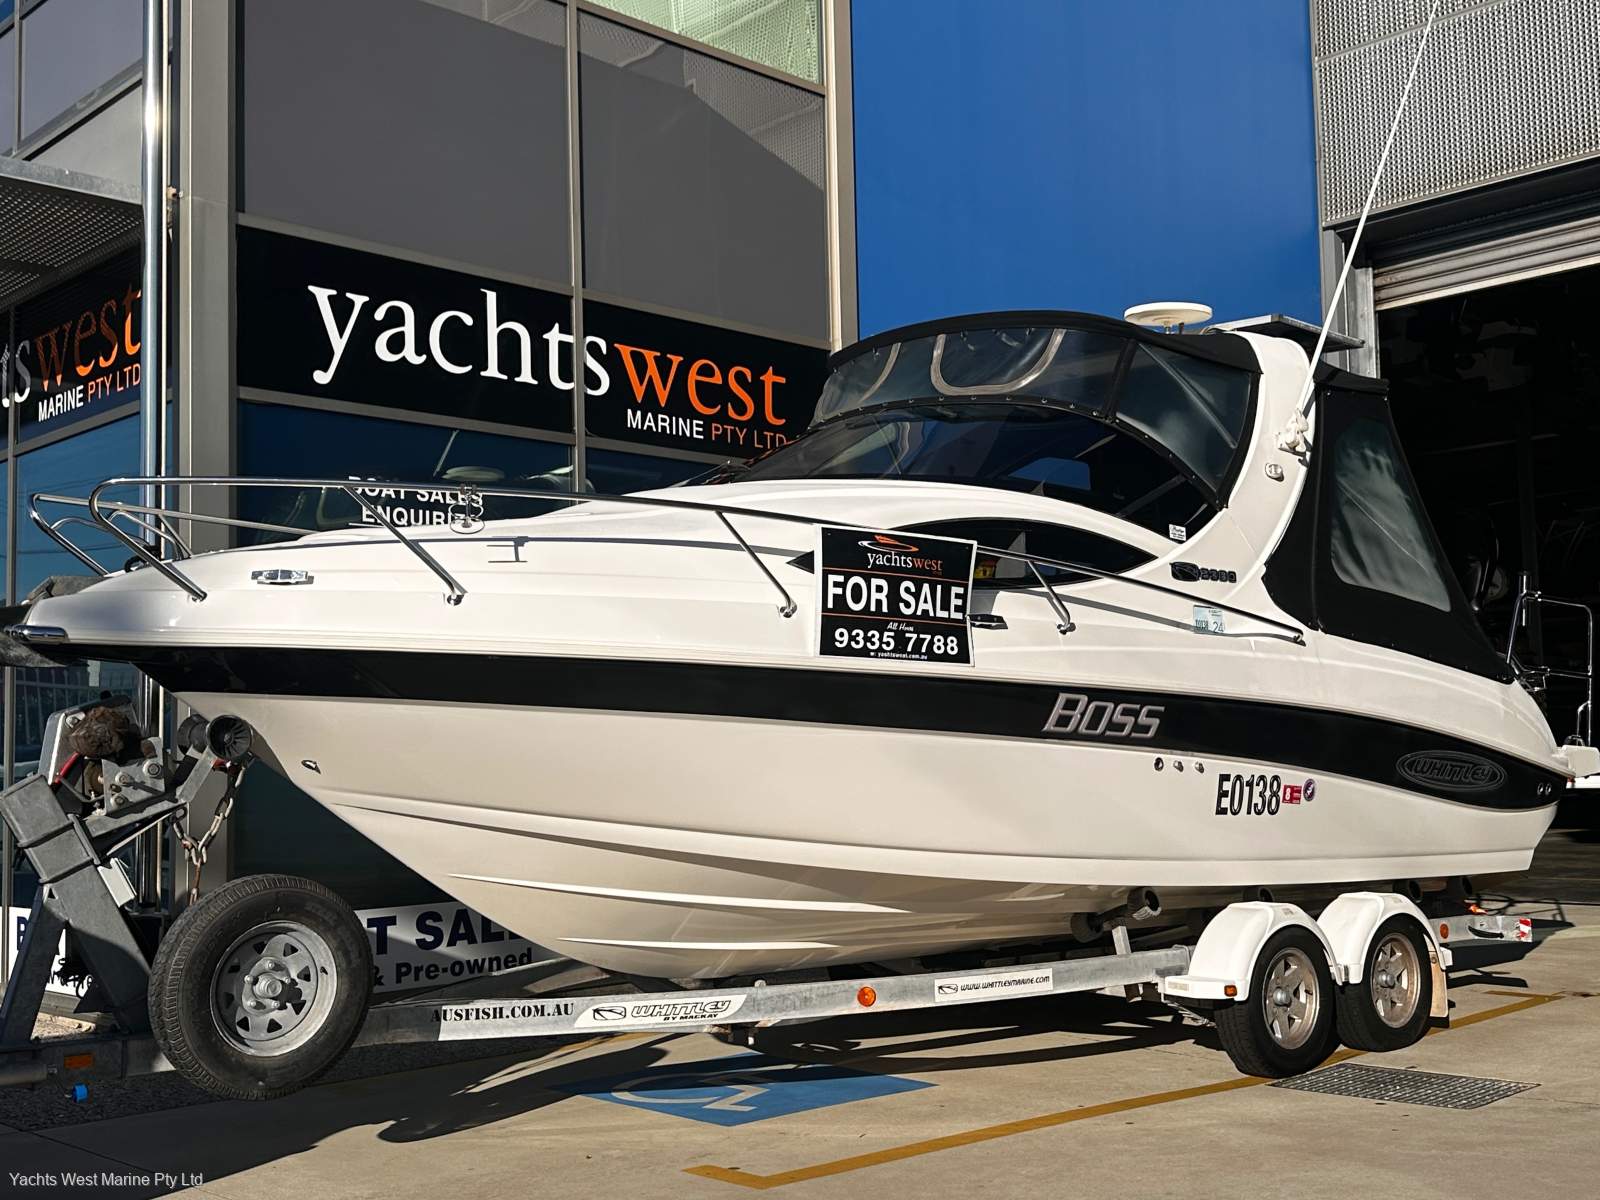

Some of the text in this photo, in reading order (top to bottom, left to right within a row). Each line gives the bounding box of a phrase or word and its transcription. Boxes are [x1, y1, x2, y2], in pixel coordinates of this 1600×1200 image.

[307, 285, 786, 426] yachtswest
[38, 363, 141, 422] MARINE PTY LTD
[627, 408, 704, 440] MARINE
[711, 423, 747, 445] PTY
[867, 551, 943, 571] yachtswest
[827, 574, 965, 620] FOR SALE
[834, 628, 959, 655] 9335 7788
[1041, 692, 1165, 738] BOSS
[1411, 758, 1492, 784] WHITTLEY
[1215, 774, 1281, 815] E0138
[415, 908, 524, 950] SAL
[395, 947, 532, 985] Pre-owned
[431, 1003, 574, 1022] AUSFISH.COM.AU
[631, 1000, 731, 1017] WHITTLEY
